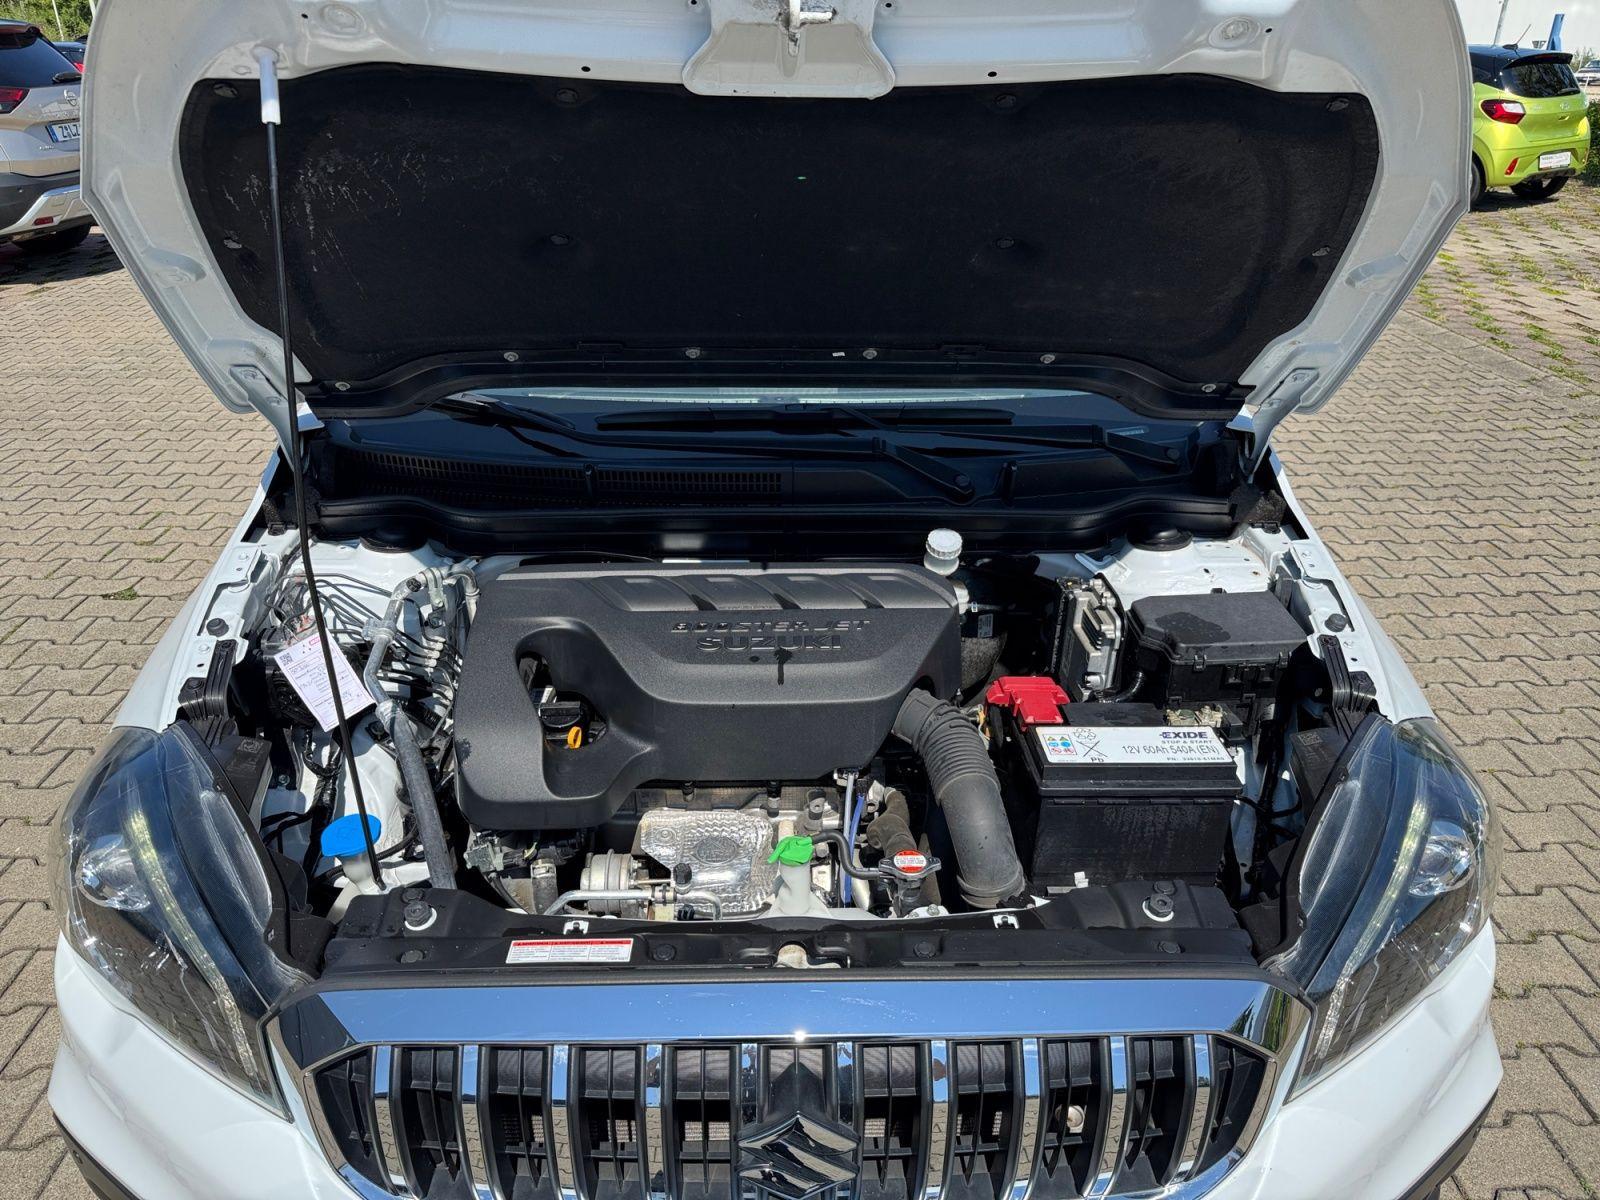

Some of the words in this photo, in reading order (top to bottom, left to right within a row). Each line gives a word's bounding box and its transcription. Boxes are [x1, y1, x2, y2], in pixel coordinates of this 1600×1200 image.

[696, 634, 841, 651] SUZUKI
[1160, 731, 1208, 739] EXIDE
[1122, 746, 1140, 754] 12V
[1143, 746, 1169, 754] 60Ah
[1170, 746, 1197, 754] 540A
[1197, 745, 1220, 755] (EN)
